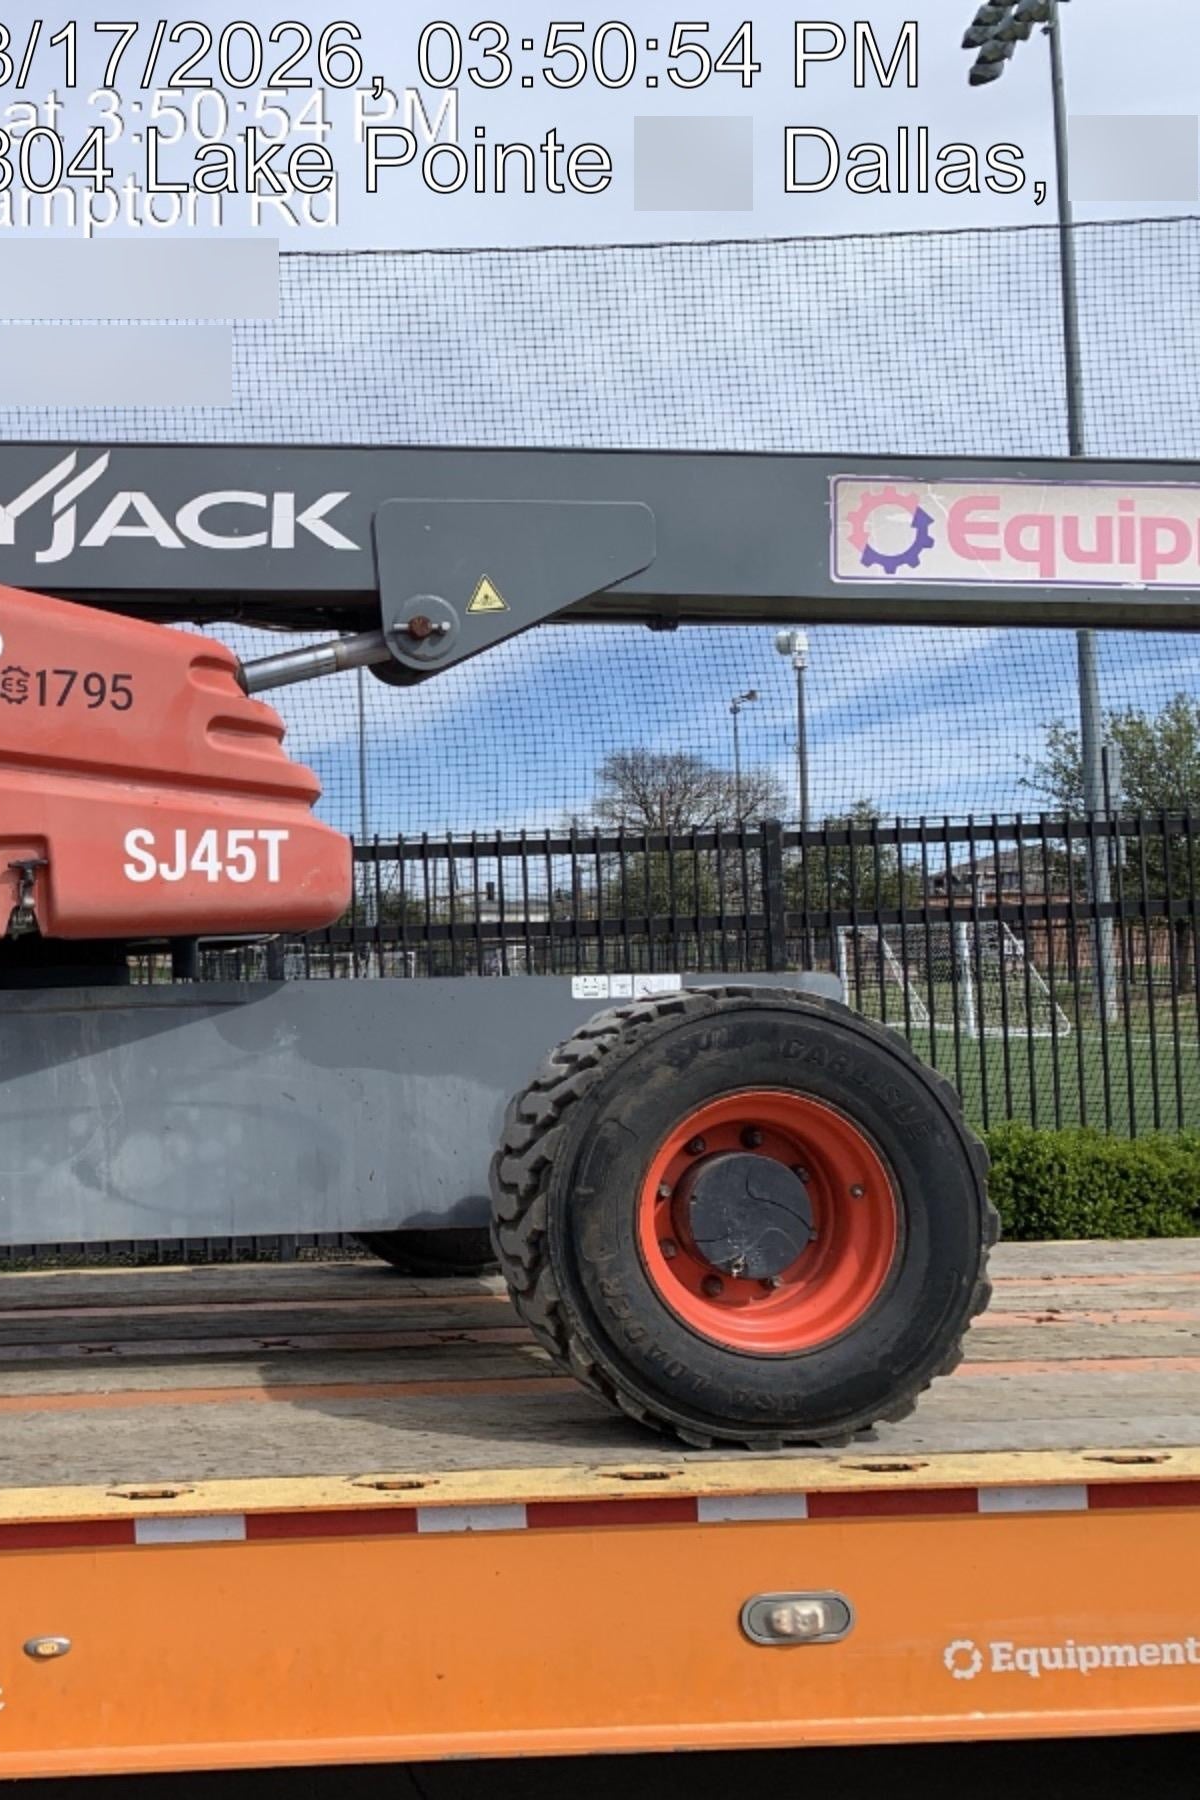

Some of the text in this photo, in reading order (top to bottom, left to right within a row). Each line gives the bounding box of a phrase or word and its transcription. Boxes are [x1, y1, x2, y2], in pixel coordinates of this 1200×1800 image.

[947, 495, 1200, 581] Equip
[36, 669, 133, 711] 1795
[123, 828, 290, 883] SJ45T
